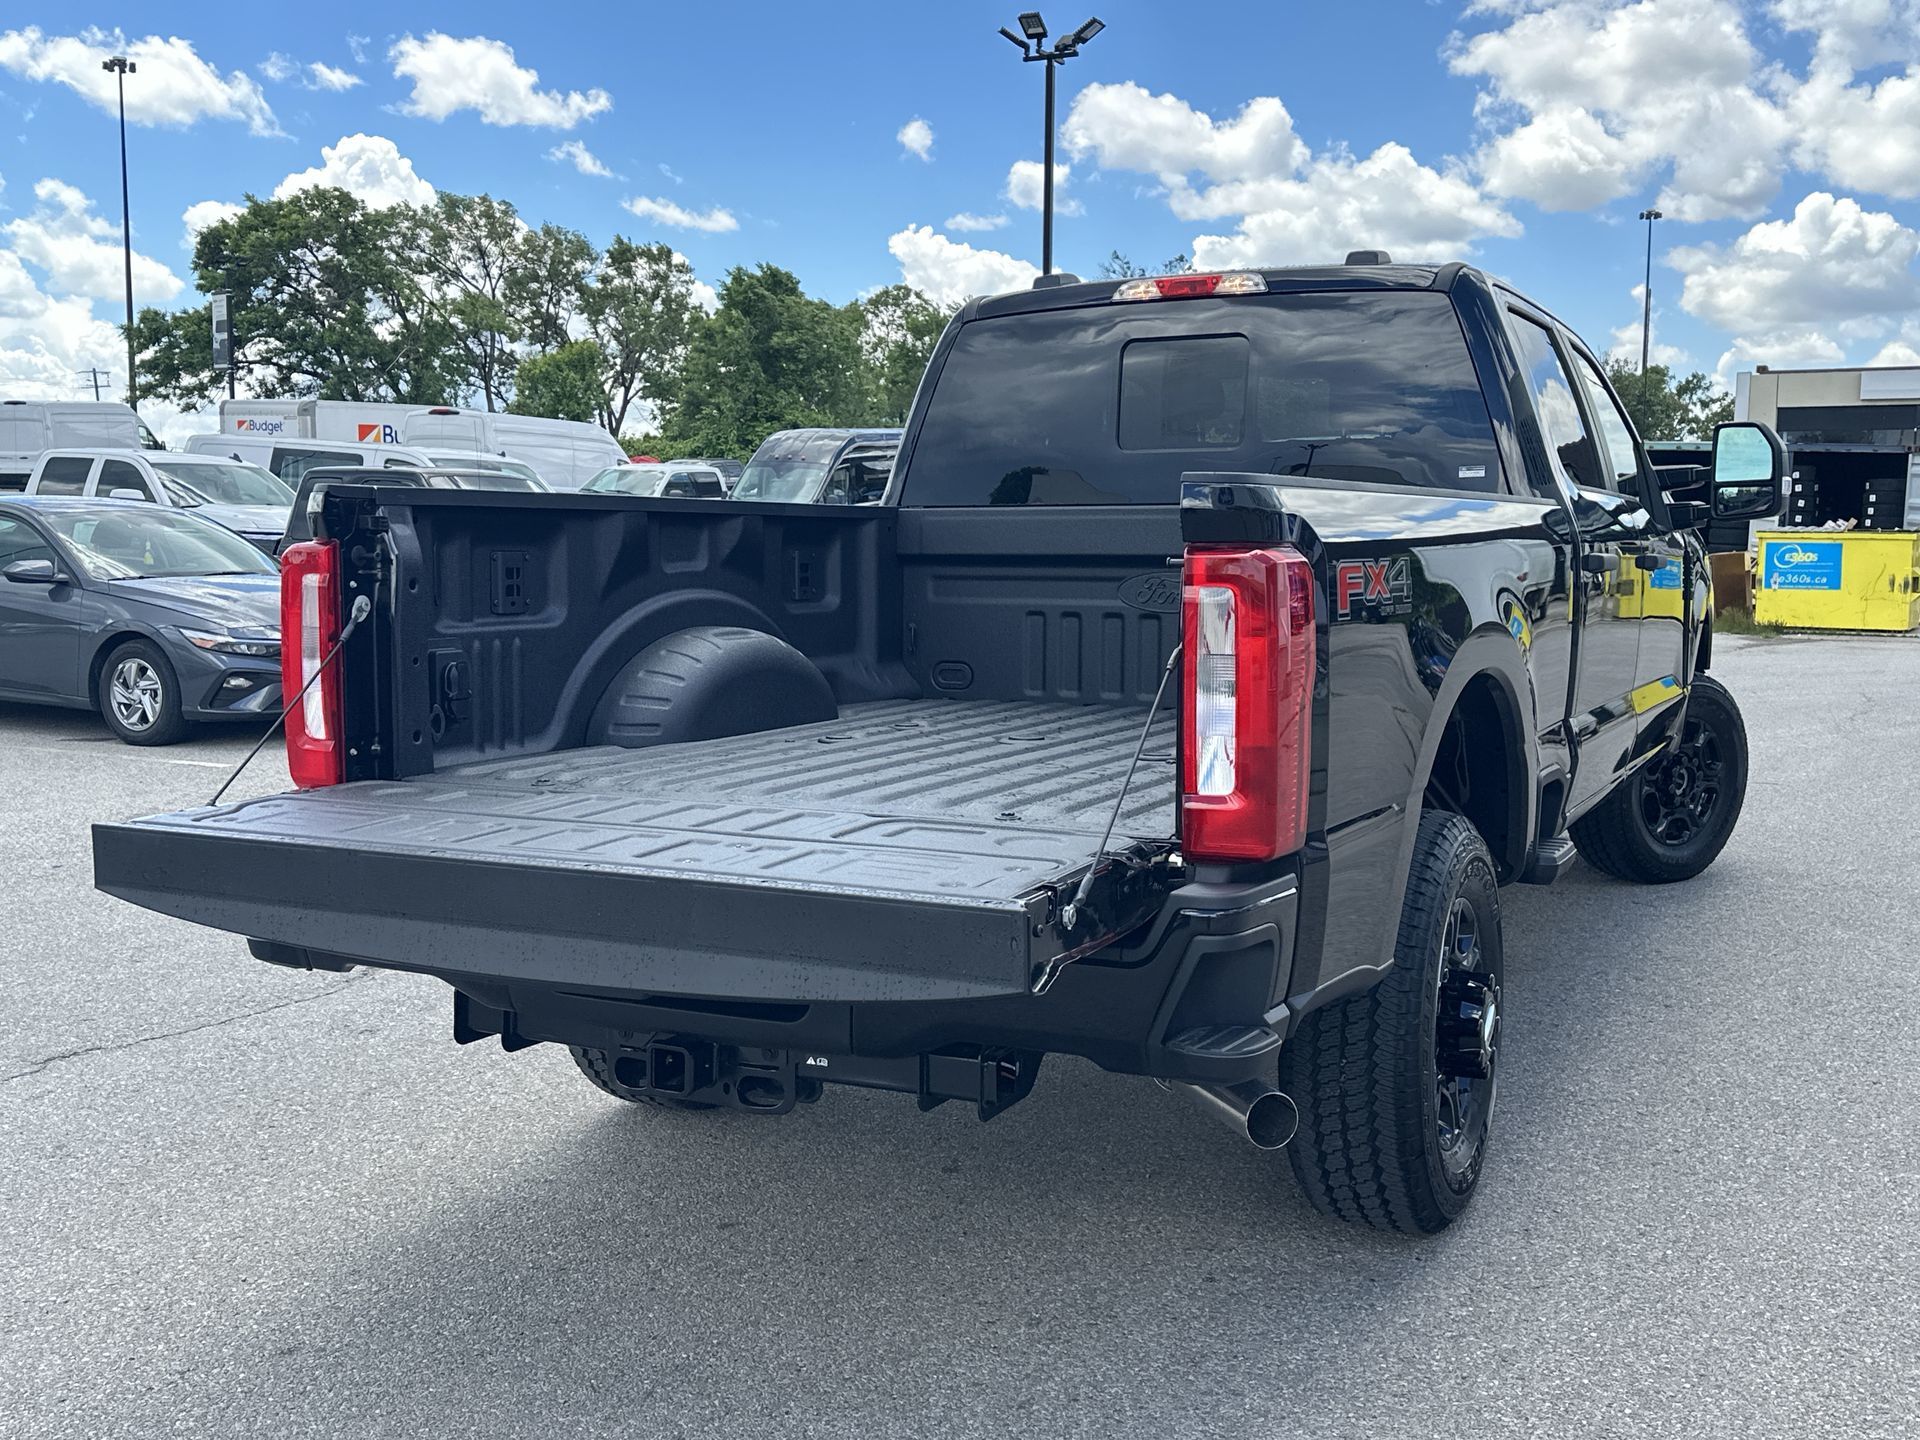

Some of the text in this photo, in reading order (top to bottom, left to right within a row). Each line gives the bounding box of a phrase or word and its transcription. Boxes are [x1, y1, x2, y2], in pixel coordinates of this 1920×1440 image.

[249, 419, 284, 435] Budget
[1136, 576, 1180, 605] For
[1337, 557, 1413, 620] FX4
